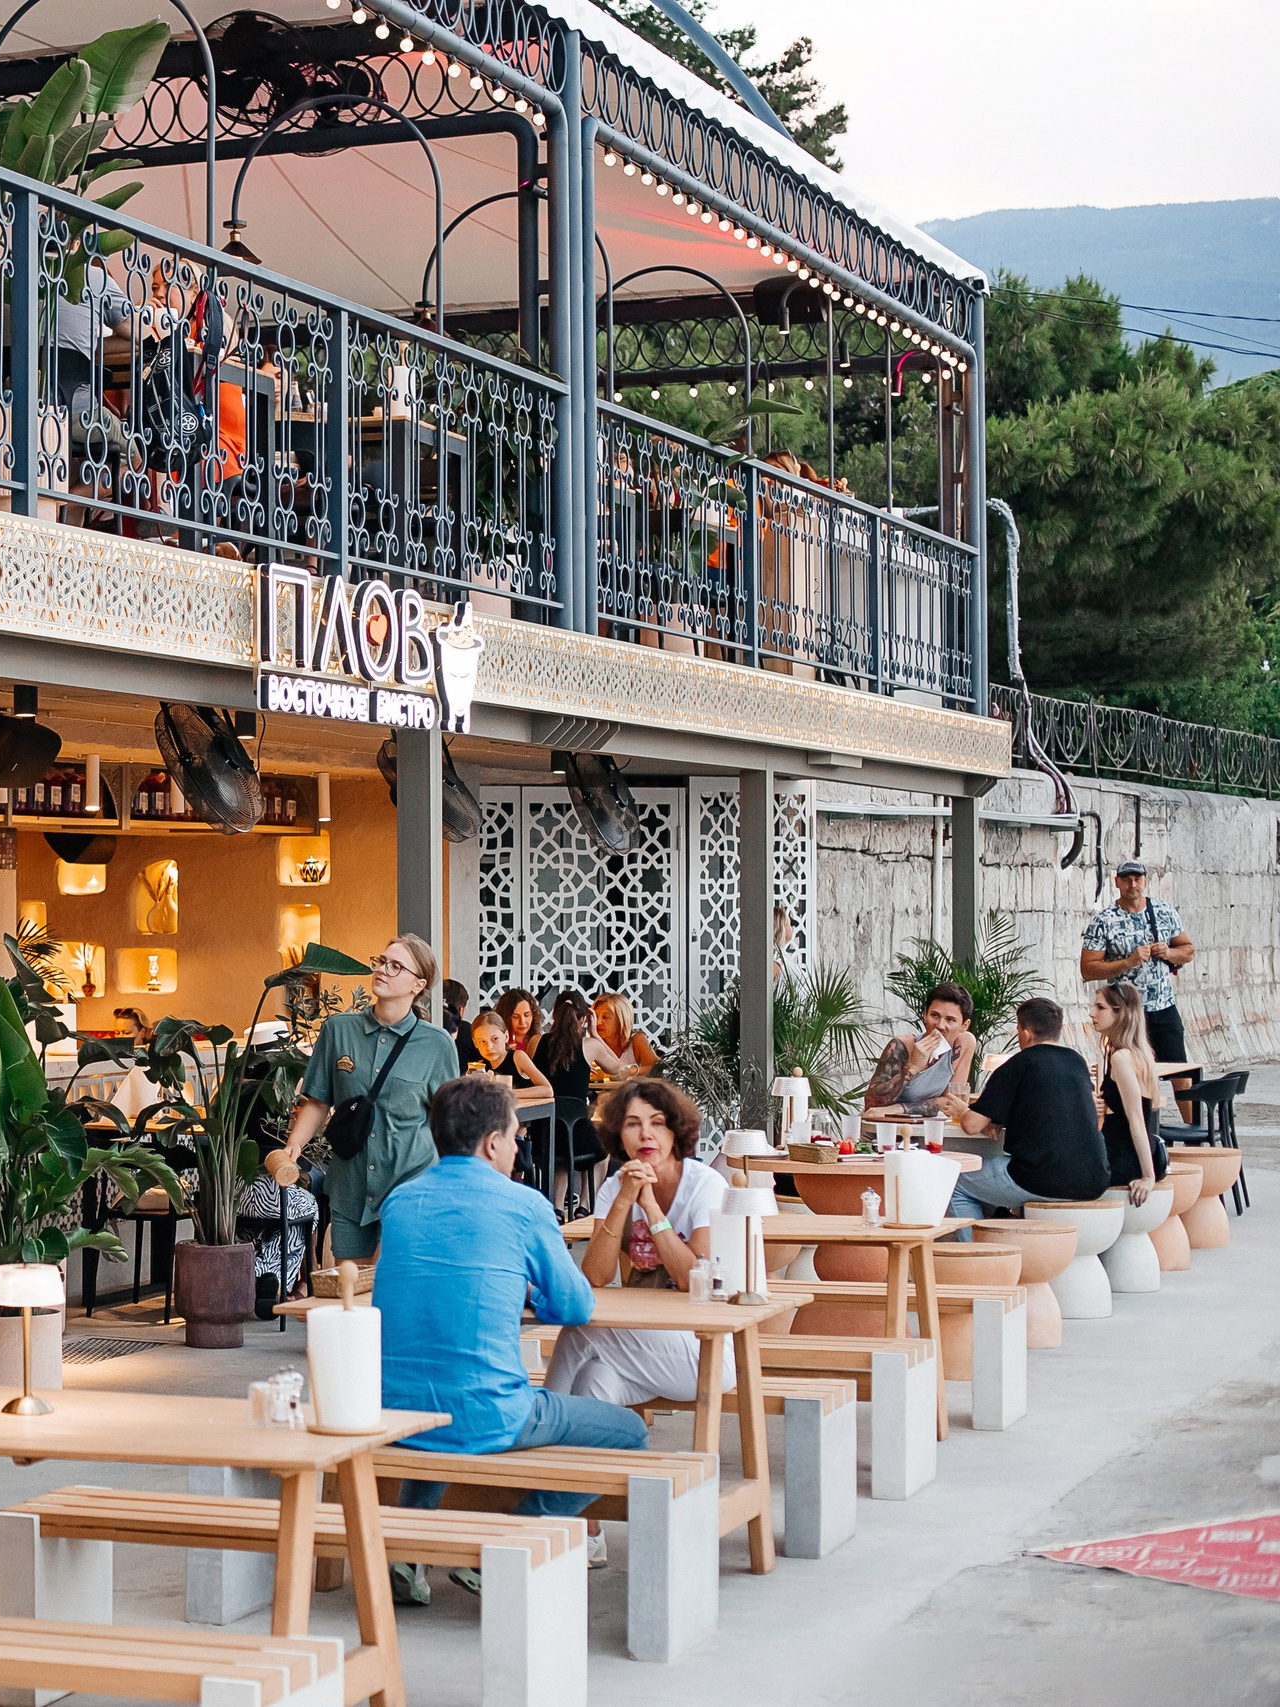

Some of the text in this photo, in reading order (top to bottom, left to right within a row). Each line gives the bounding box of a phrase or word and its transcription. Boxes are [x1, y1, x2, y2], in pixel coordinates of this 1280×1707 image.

[265, 562, 435, 684] ПЛОВ
[268, 674, 436, 730] ВОСТОЧНОЕ БИСТРО
